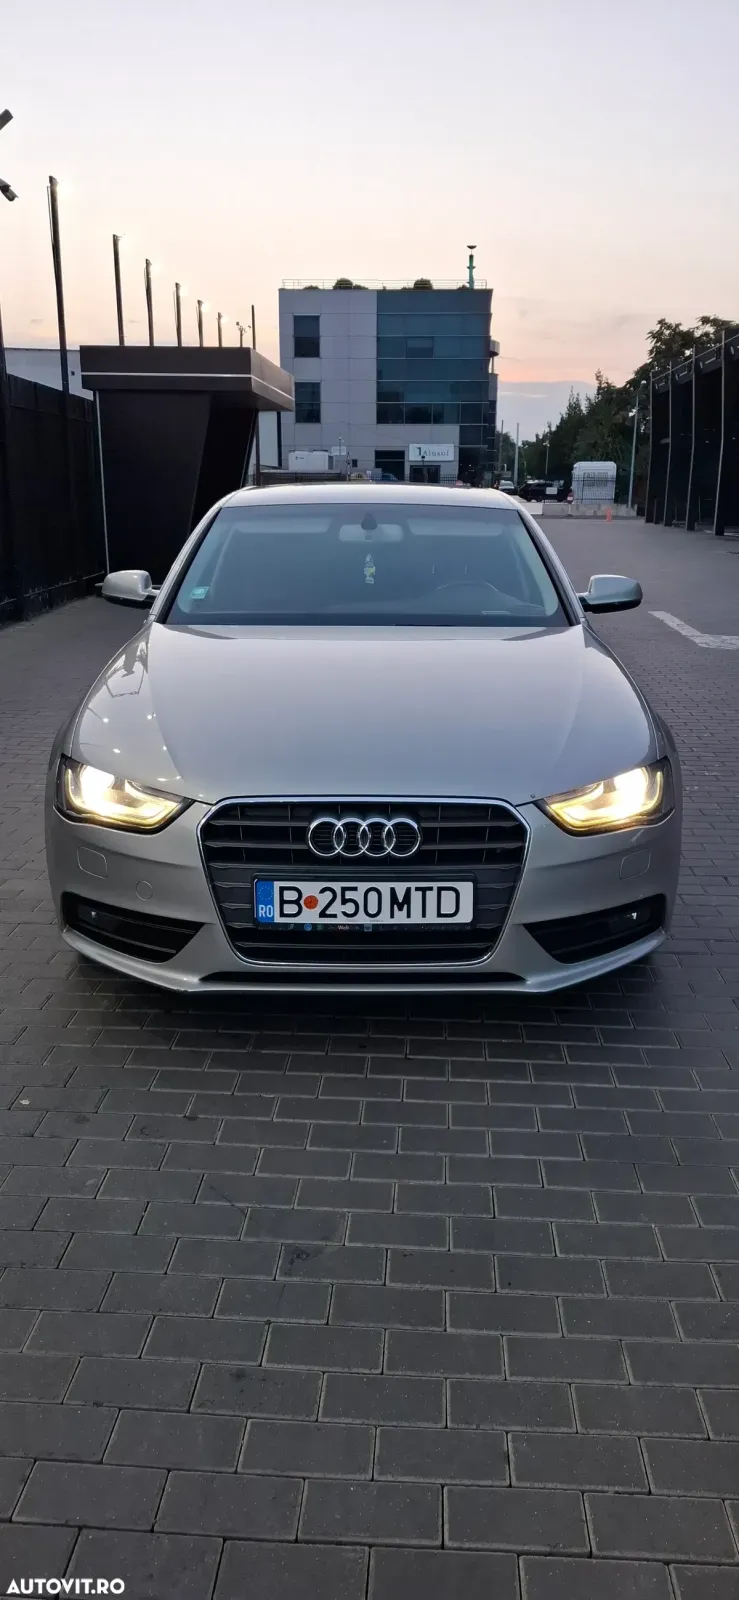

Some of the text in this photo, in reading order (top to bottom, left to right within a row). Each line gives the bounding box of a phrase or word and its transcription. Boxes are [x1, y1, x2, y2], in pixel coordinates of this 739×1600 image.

[259, 904, 273, 917] RO
[279, 886, 460, 918] B 250 MTD
